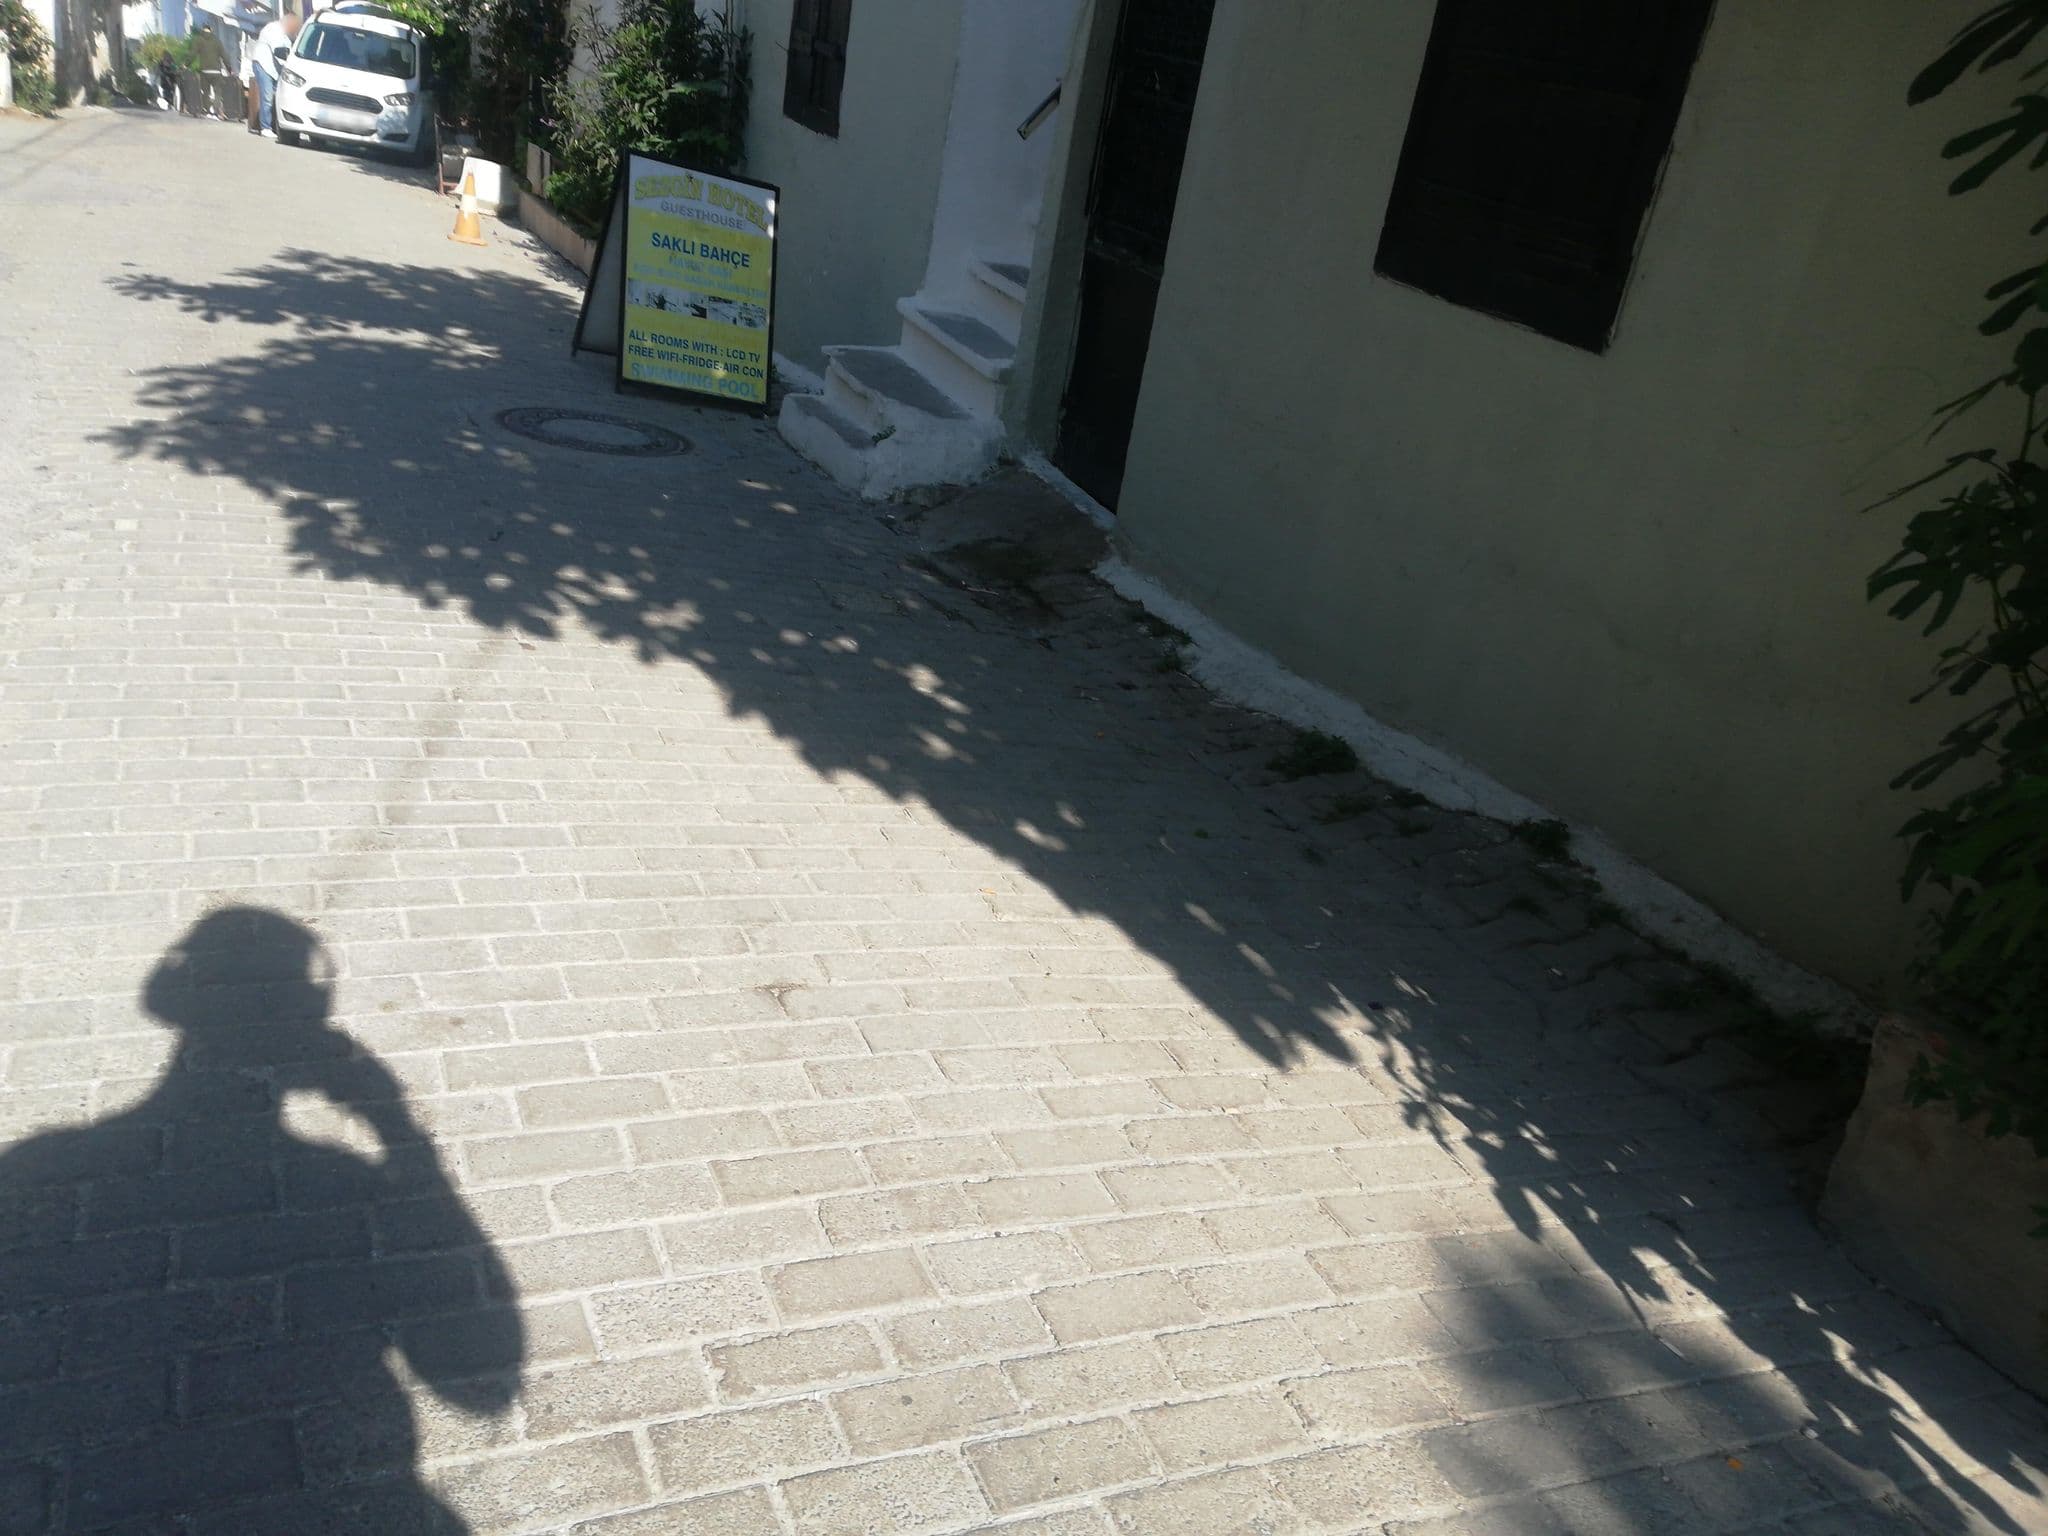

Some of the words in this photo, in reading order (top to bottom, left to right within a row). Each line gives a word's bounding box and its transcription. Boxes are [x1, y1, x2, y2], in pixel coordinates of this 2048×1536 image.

[661, 201, 745, 230] GUESTHOUSE
[651, 232, 695, 255] SAKLI
[700, 244, 750, 269] BAHÇE
[628, 345, 654, 358] FREE
[742, 365, 764, 379] CON
[629, 329, 647, 342] ALL
[651, 333, 689, 349] ROOMS
[692, 339, 718, 354] WITH
[727, 348, 746, 362] LCD
[749, 352, 761, 363] TV
[719, 378, 760, 398] POOL
